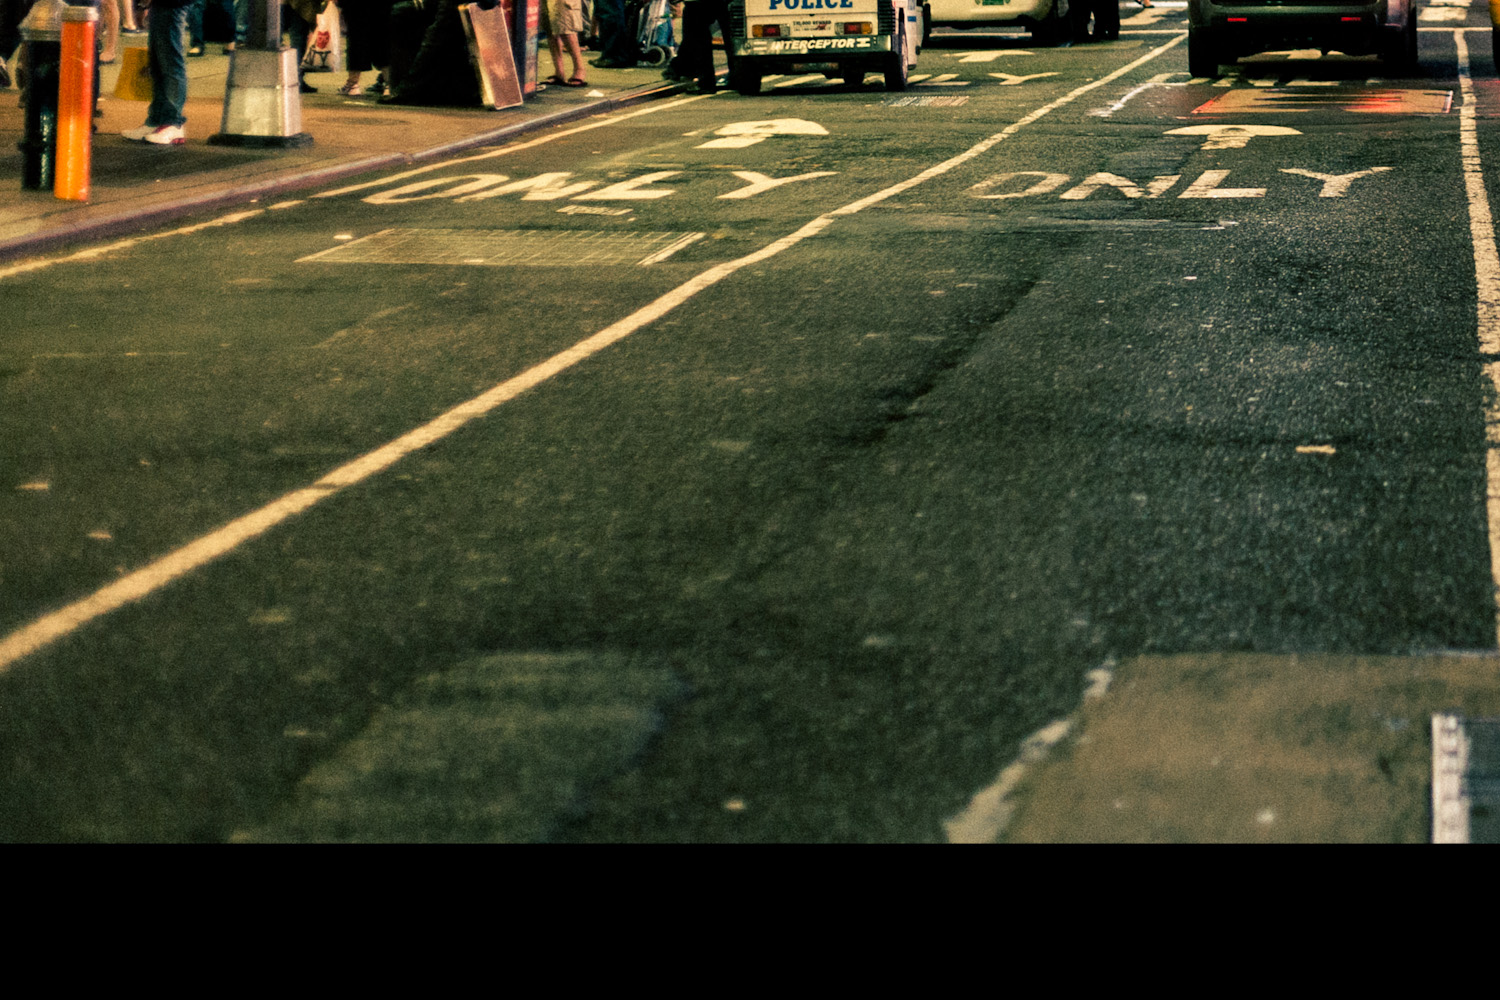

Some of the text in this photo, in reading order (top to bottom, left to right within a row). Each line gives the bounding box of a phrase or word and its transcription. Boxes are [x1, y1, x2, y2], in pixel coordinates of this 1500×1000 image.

[771, 37, 855, 51] INTERCEPTOR
[361, 169, 841, 203] ONLY
[971, 166, 1393, 201] ONLY
